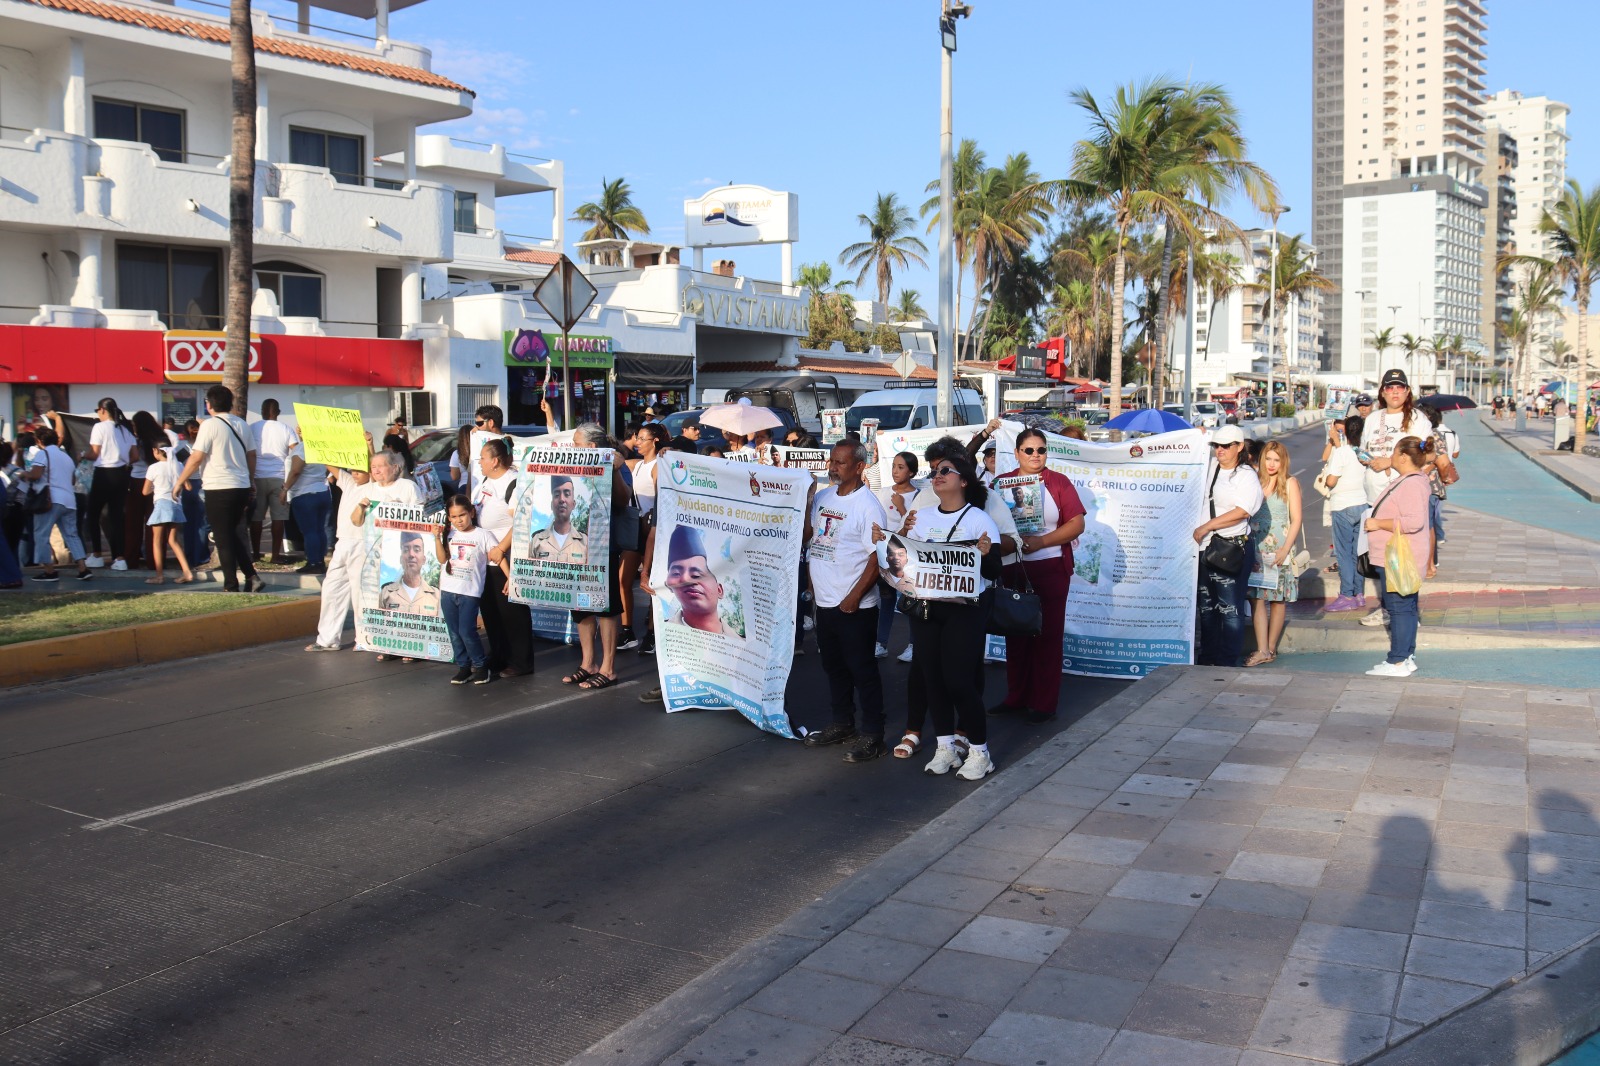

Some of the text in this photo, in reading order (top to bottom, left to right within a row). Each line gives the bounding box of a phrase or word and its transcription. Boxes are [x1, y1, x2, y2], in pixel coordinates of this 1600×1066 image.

[728, 200, 772, 209] VISTAMAR
[708, 293, 810, 331] VISTAMAR
[1047, 444, 1080, 456] inaloa
[530, 452, 599, 465] DESAPARECIDO
[798, 461, 826, 469] LIBERTAD
[528, 464, 539, 472] JOSÉ
[540, 465, 558, 473] MARTIN
[559, 466, 581, 475] CARRILLO
[1108, 468, 1176, 479] encontrar
[690, 475, 717, 489] Sinaloa
[1088, 481, 1137, 490] CARRILLO
[1140, 482, 1185, 492] GODÍNEZ
[677, 496, 724, 515] Ayúdanos
[727, 508, 732, 516] a
[736, 510, 784, 524] encontrar
[390, 521, 408, 530] MARTIN
[410, 523, 431, 532] CARRILLO
[694, 517, 720, 530] MARTIN
[722, 522, 750, 536] CARRILLO
[917, 550, 975, 567] EXIJIMOS
[569, 563, 583, 571] DESDE
[941, 566, 952, 574] SU
[915, 572, 975, 593] LIBERTAD
[521, 588, 572, 603] 6693262089
[372, 636, 424, 652] 6693262089
[1078, 639, 1115, 648] referente
[1151, 643, 1186, 652] persona,
[1078, 647, 1102, 655] ayuda
[1139, 650, 1186, 659] importante.
[734, 699, 759, 715] referente
